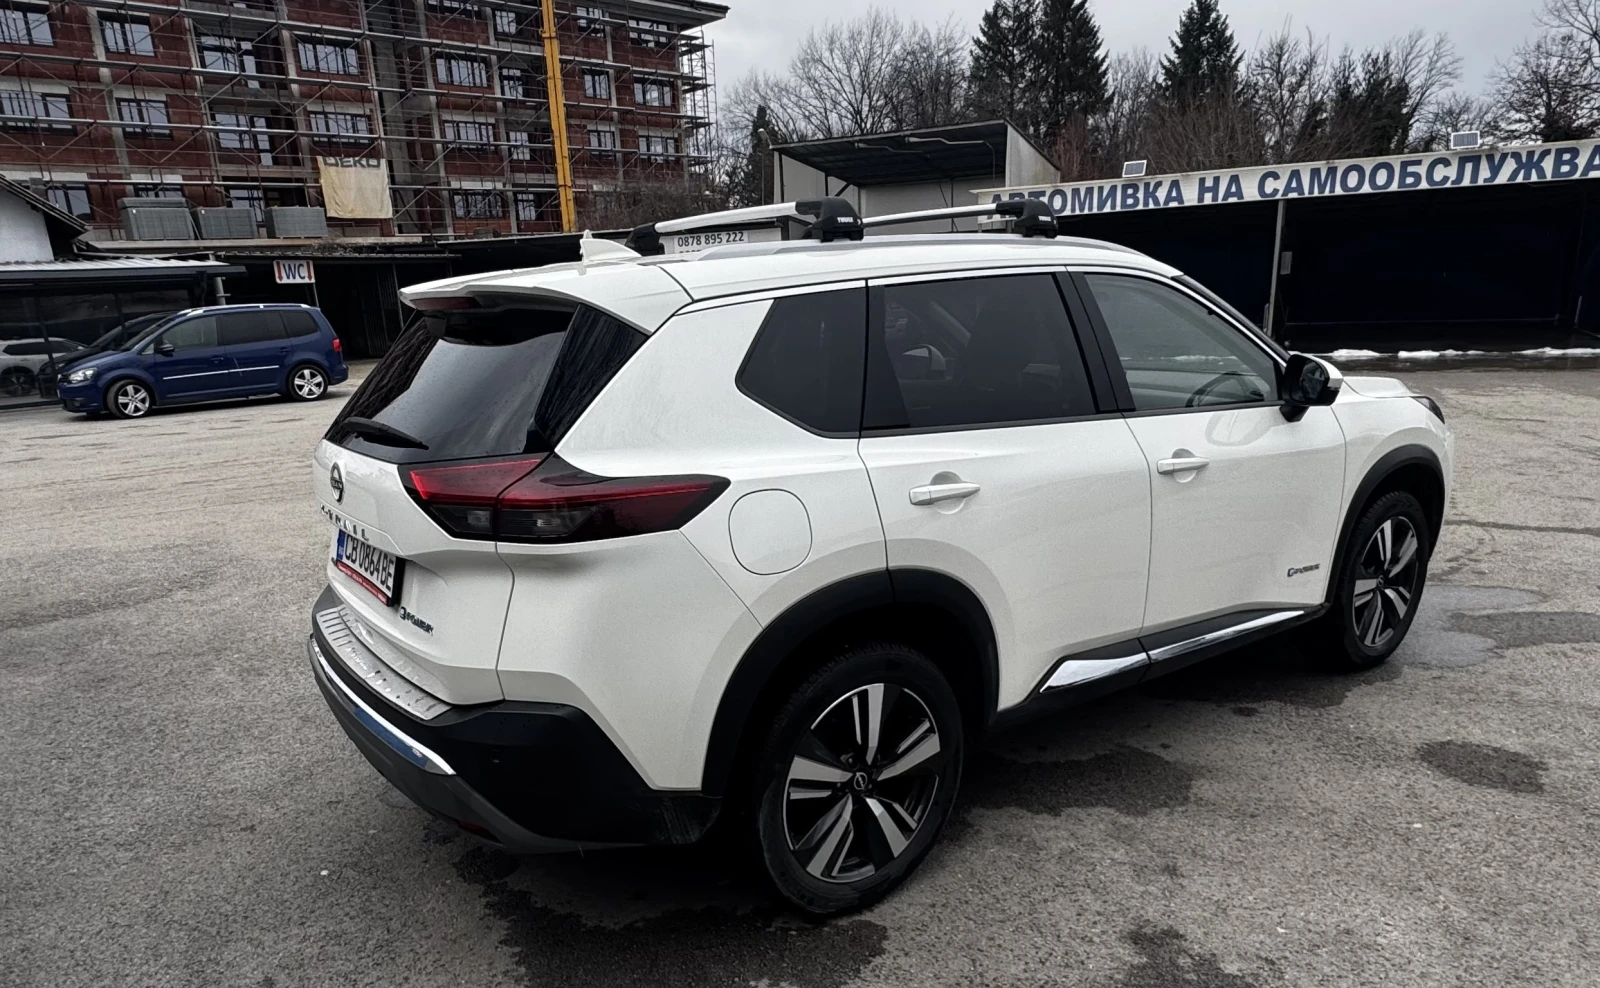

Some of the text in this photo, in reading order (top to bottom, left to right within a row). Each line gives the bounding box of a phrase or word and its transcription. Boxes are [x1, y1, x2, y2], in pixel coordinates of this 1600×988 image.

[986, 179, 1185, 220] АОМИВКА
[1197, 174, 1245, 204] НА
[677, 231, 745, 248] 0878 895 222
[282, 262, 306, 280] WC
